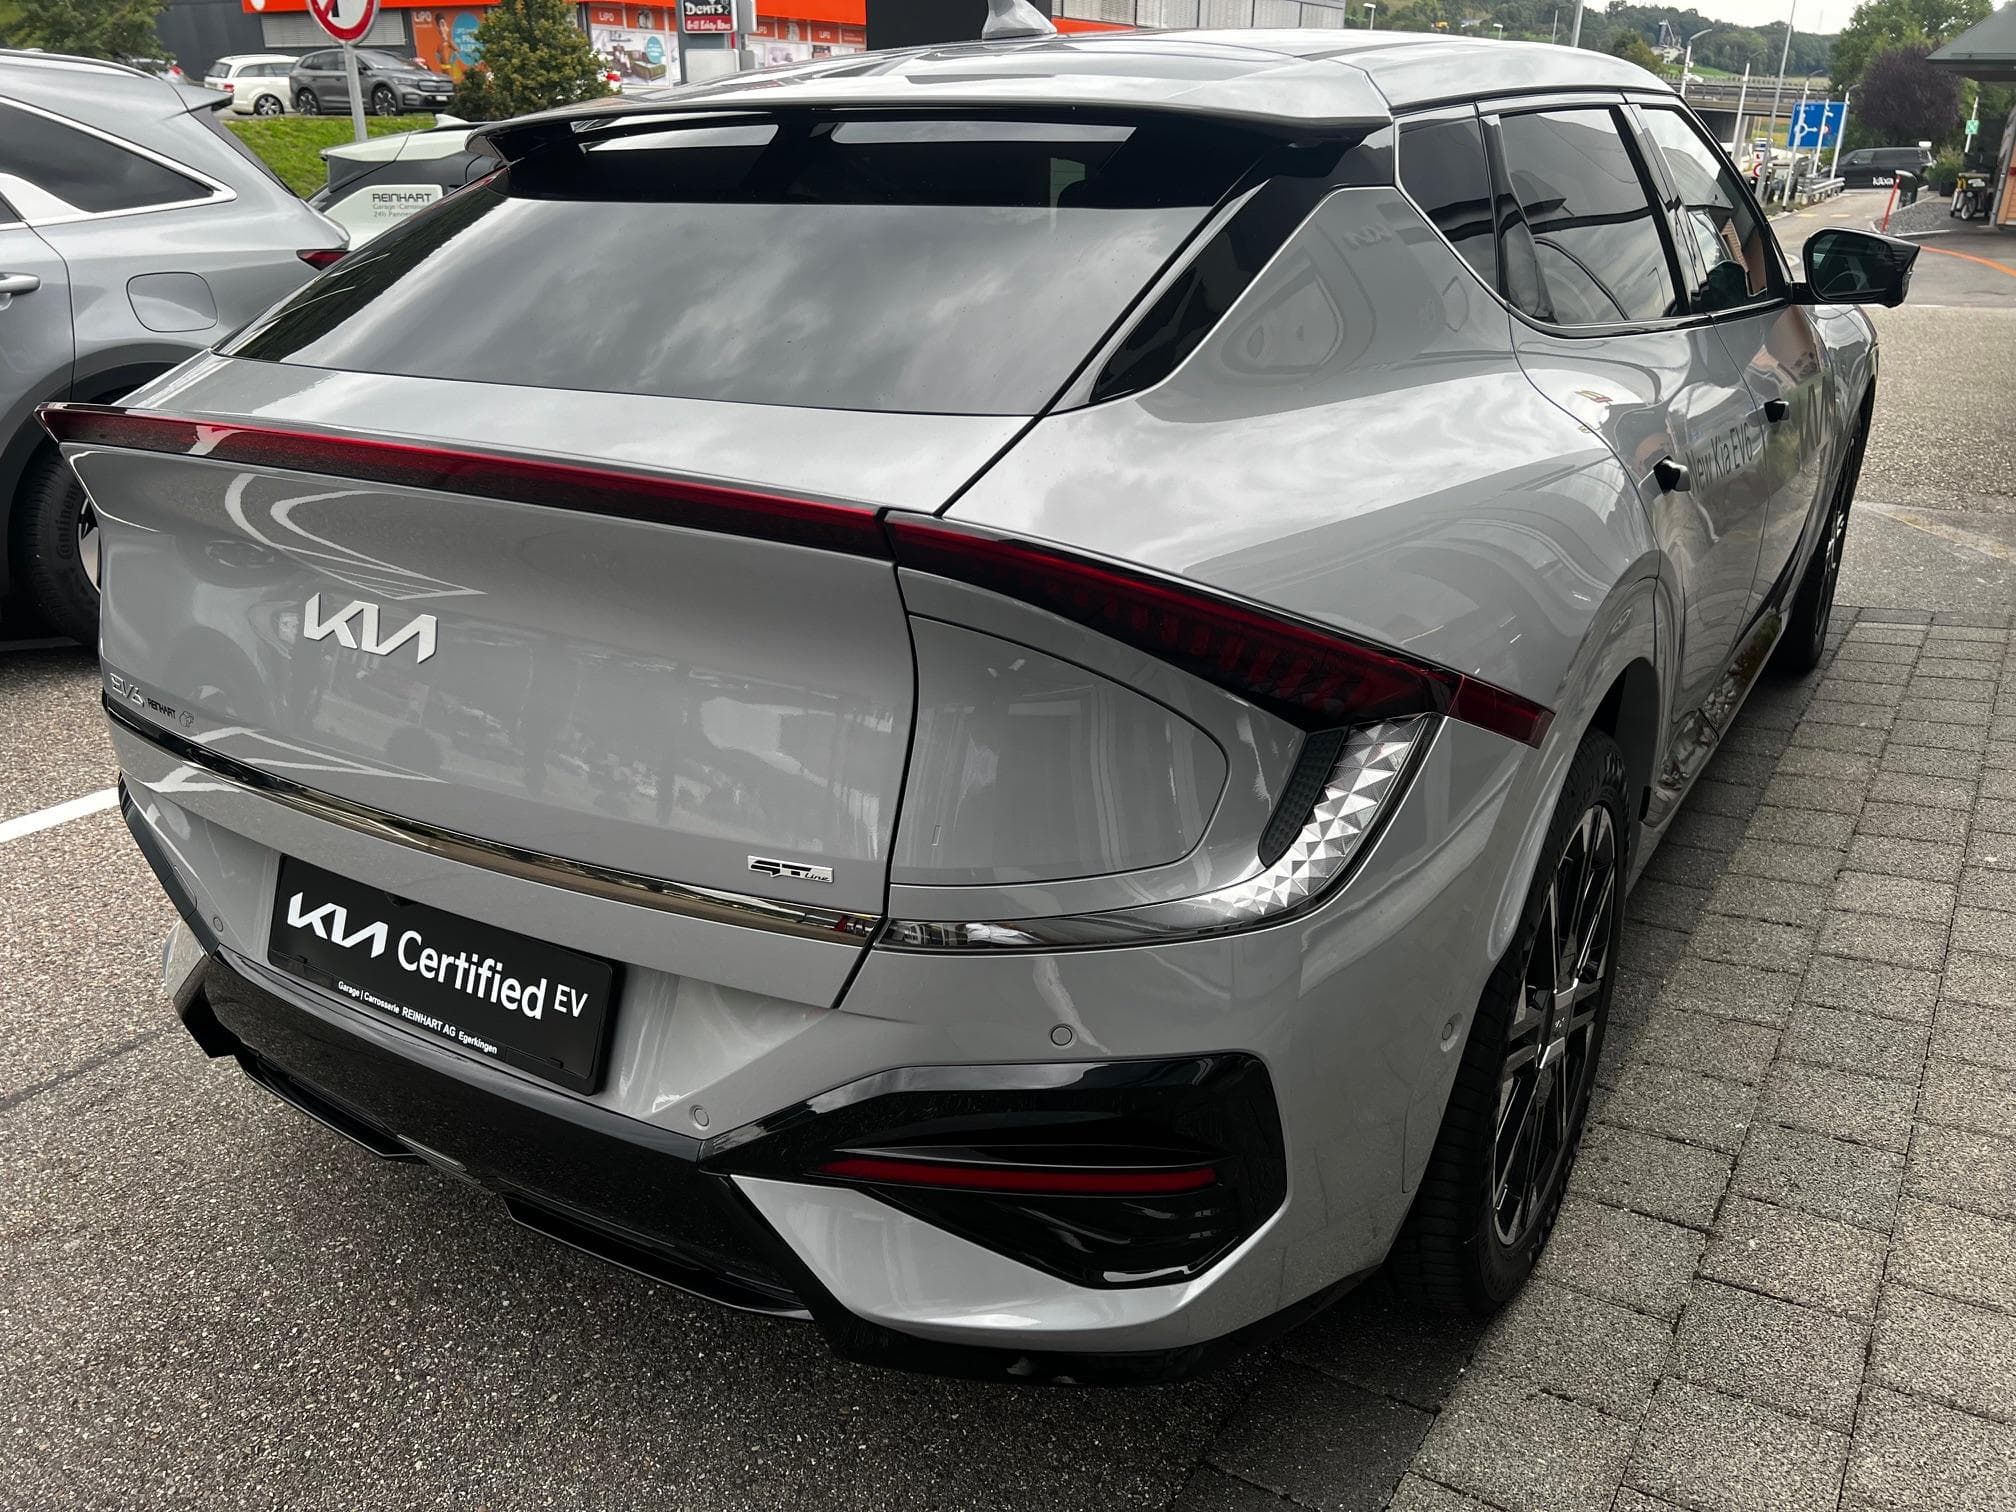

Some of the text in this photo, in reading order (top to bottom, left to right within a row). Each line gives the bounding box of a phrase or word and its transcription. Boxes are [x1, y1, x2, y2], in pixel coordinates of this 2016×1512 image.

[372, 193, 432, 203] REINHART
[303, 592, 438, 664] KIA
[109, 672, 145, 708] EV6
[287, 892, 589, 1020] KIA Certified EV
[338, 981, 360, 997] Garage
[364, 992, 400, 1014] Carrosserie
[401, 1006, 443, 1032] REINHART
[442, 1024, 456, 1037] AG
[458, 1031, 498, 1055] Egerkingen
